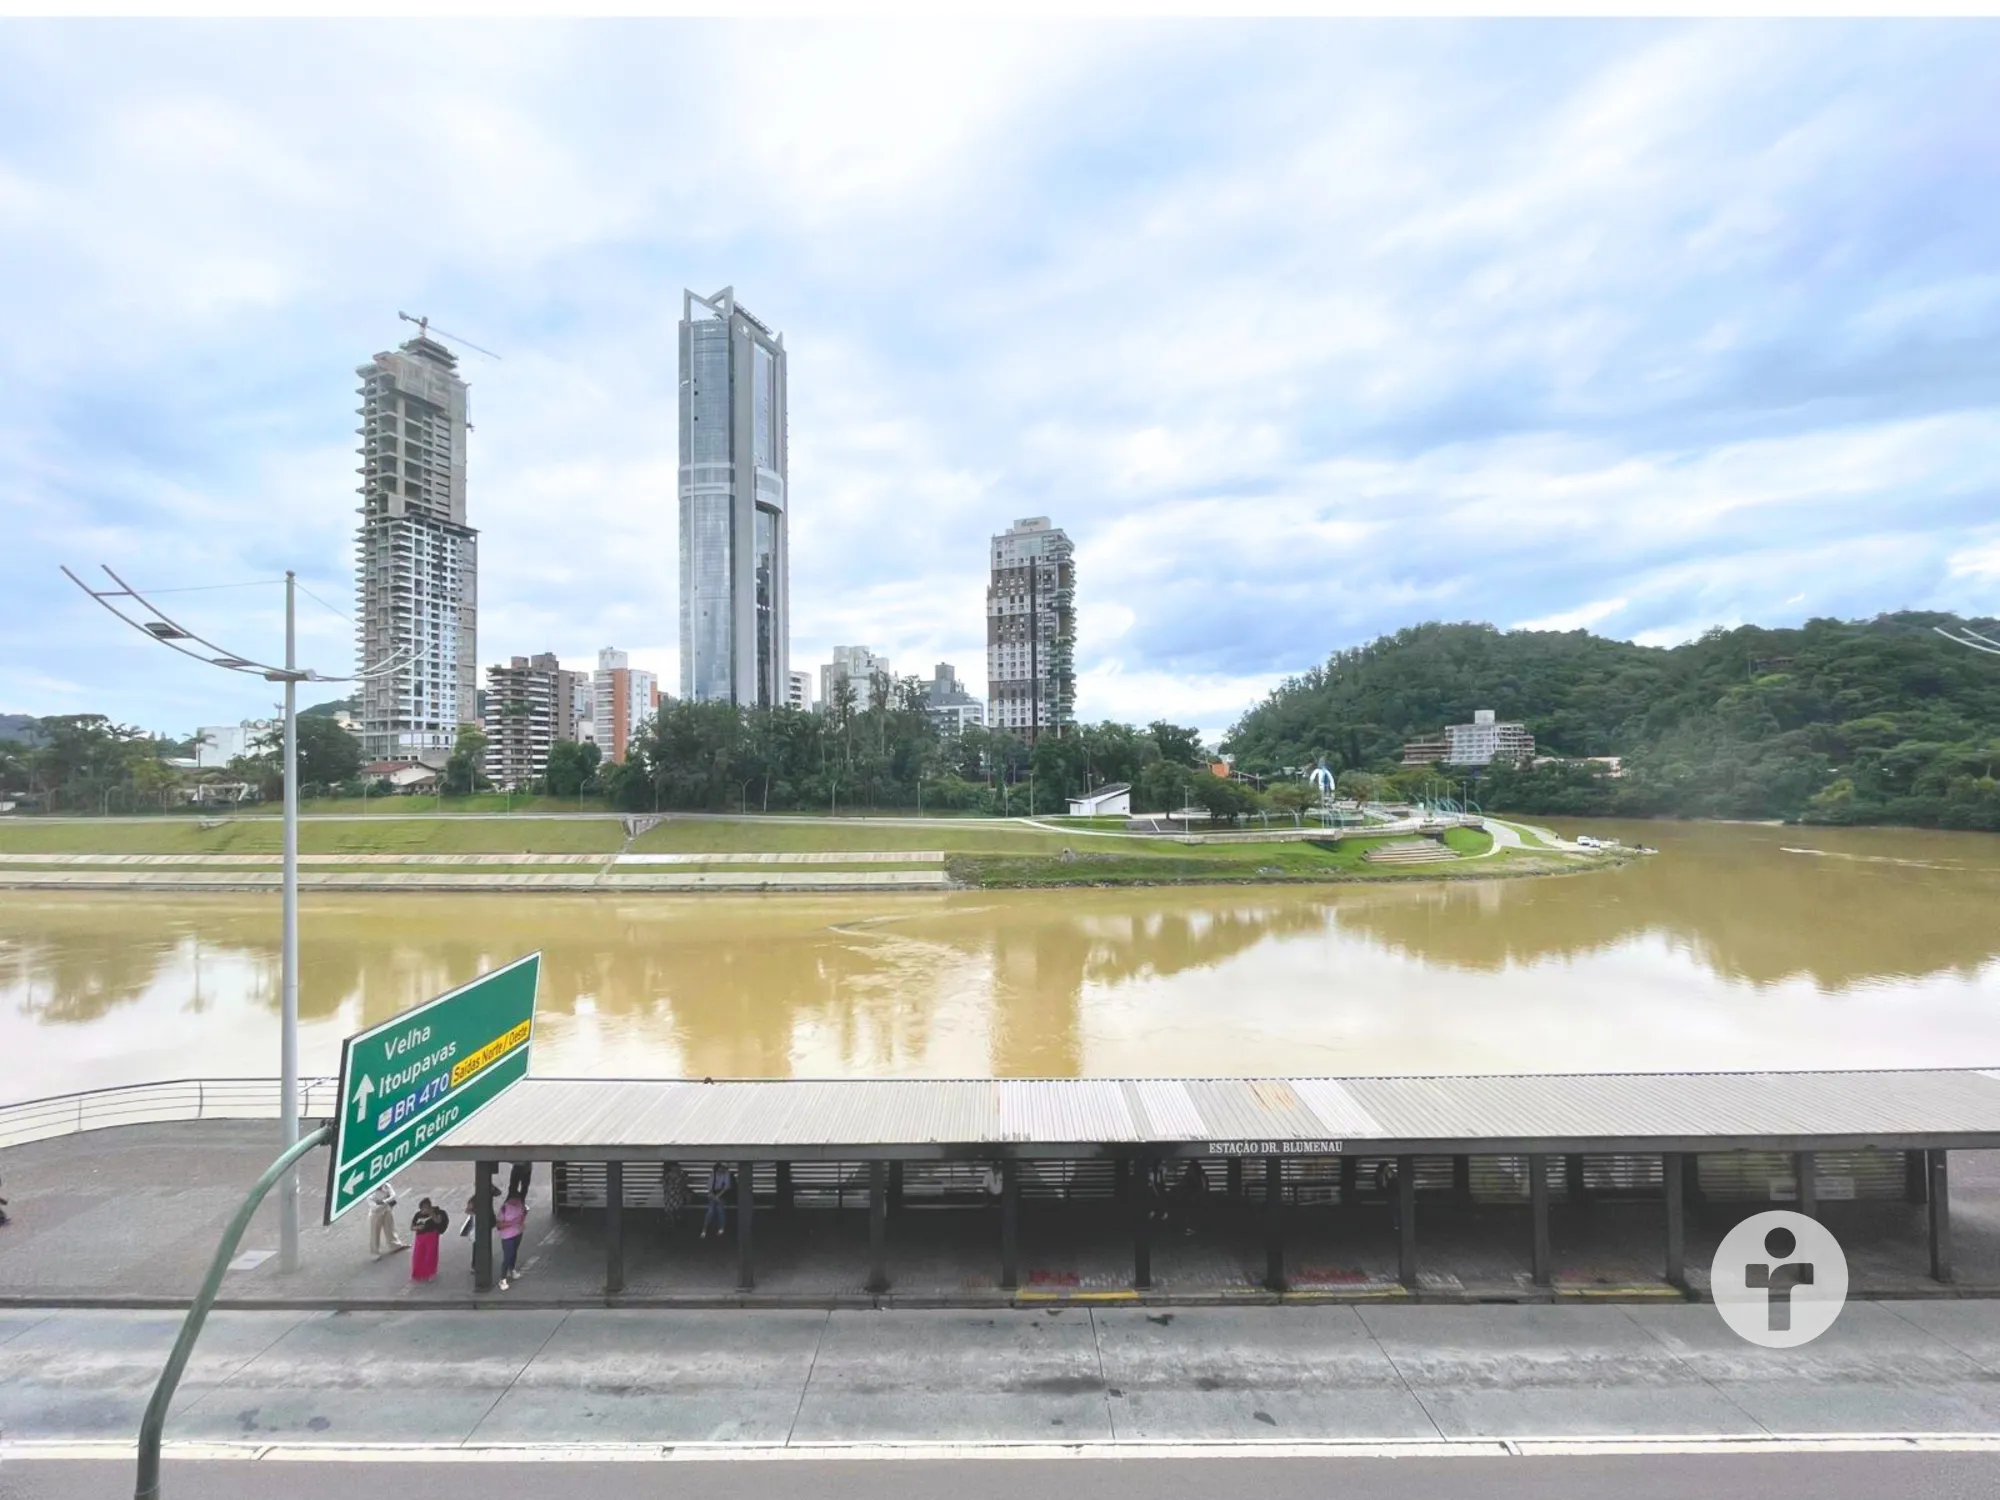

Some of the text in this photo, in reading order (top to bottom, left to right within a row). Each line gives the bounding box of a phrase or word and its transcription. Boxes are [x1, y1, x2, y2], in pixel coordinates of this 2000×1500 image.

[384, 1025, 431, 1061] Velha
[378, 1041, 457, 1099] Itoupavas
[394, 1072, 450, 1123] BR 470
[369, 1105, 460, 1181] Bom Retiro
[1208, 1139, 1344, 1157] ESTAÇÃO DR. BLUMENAU
